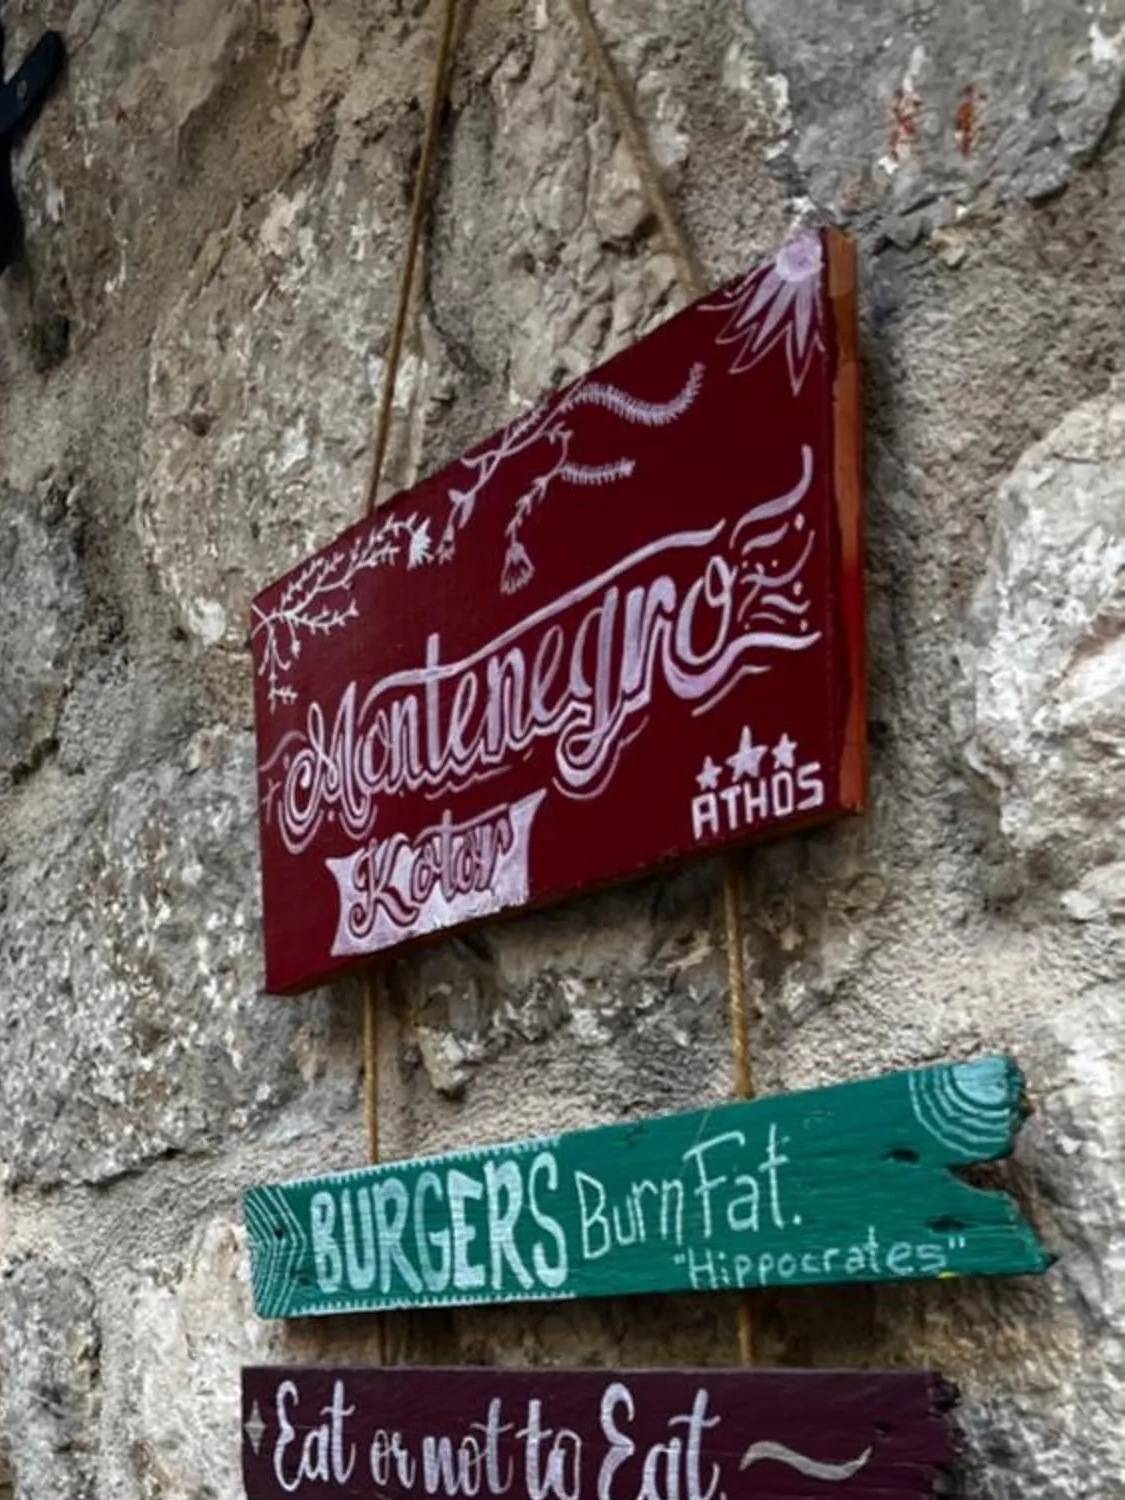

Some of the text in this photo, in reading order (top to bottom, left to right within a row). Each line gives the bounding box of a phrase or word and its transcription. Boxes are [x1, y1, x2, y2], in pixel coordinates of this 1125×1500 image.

[277, 518, 733, 855] Montenegro
[691, 763, 825, 841] ATHOS
[349, 808, 517, 942] Kotor
[311, 1122, 804, 1295] BURGERS Burn Fat.
[274, 1379, 357, 1493] Eat
[369, 1428, 416, 1488] or
[422, 1397, 515, 1497] not
